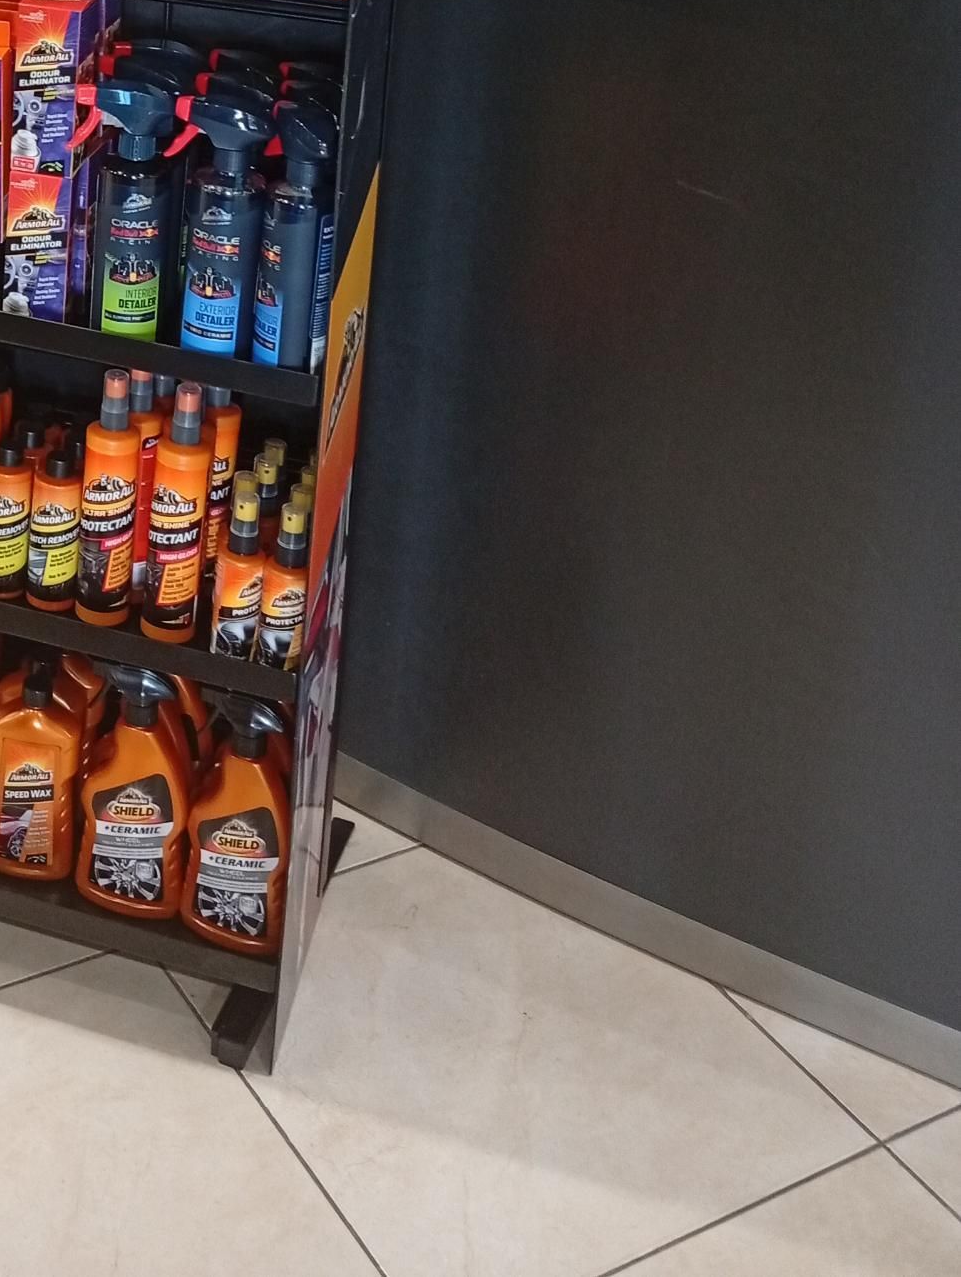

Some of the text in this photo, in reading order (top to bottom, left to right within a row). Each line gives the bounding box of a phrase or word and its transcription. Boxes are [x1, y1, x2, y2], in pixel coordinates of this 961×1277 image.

[29, 69, 61, 79] ODOUR
[18, 75, 72, 88] ELIMINATOR
[21, 234, 53, 244] ODOUR
[193, 227, 241, 246] ORACLE
[10, 240, 63, 252] ELIMINATOR
[118, 297, 157, 310] DETAILER
[198, 302, 237, 314] EXTERIOR
[195, 312, 236, 326] DETAILER
[163, 520, 191, 529] SHINE
[4, 788, 52, 800] SPEED WAX
[112, 805, 155, 818] SHIELD
[217, 836, 260, 850] SHIELD
